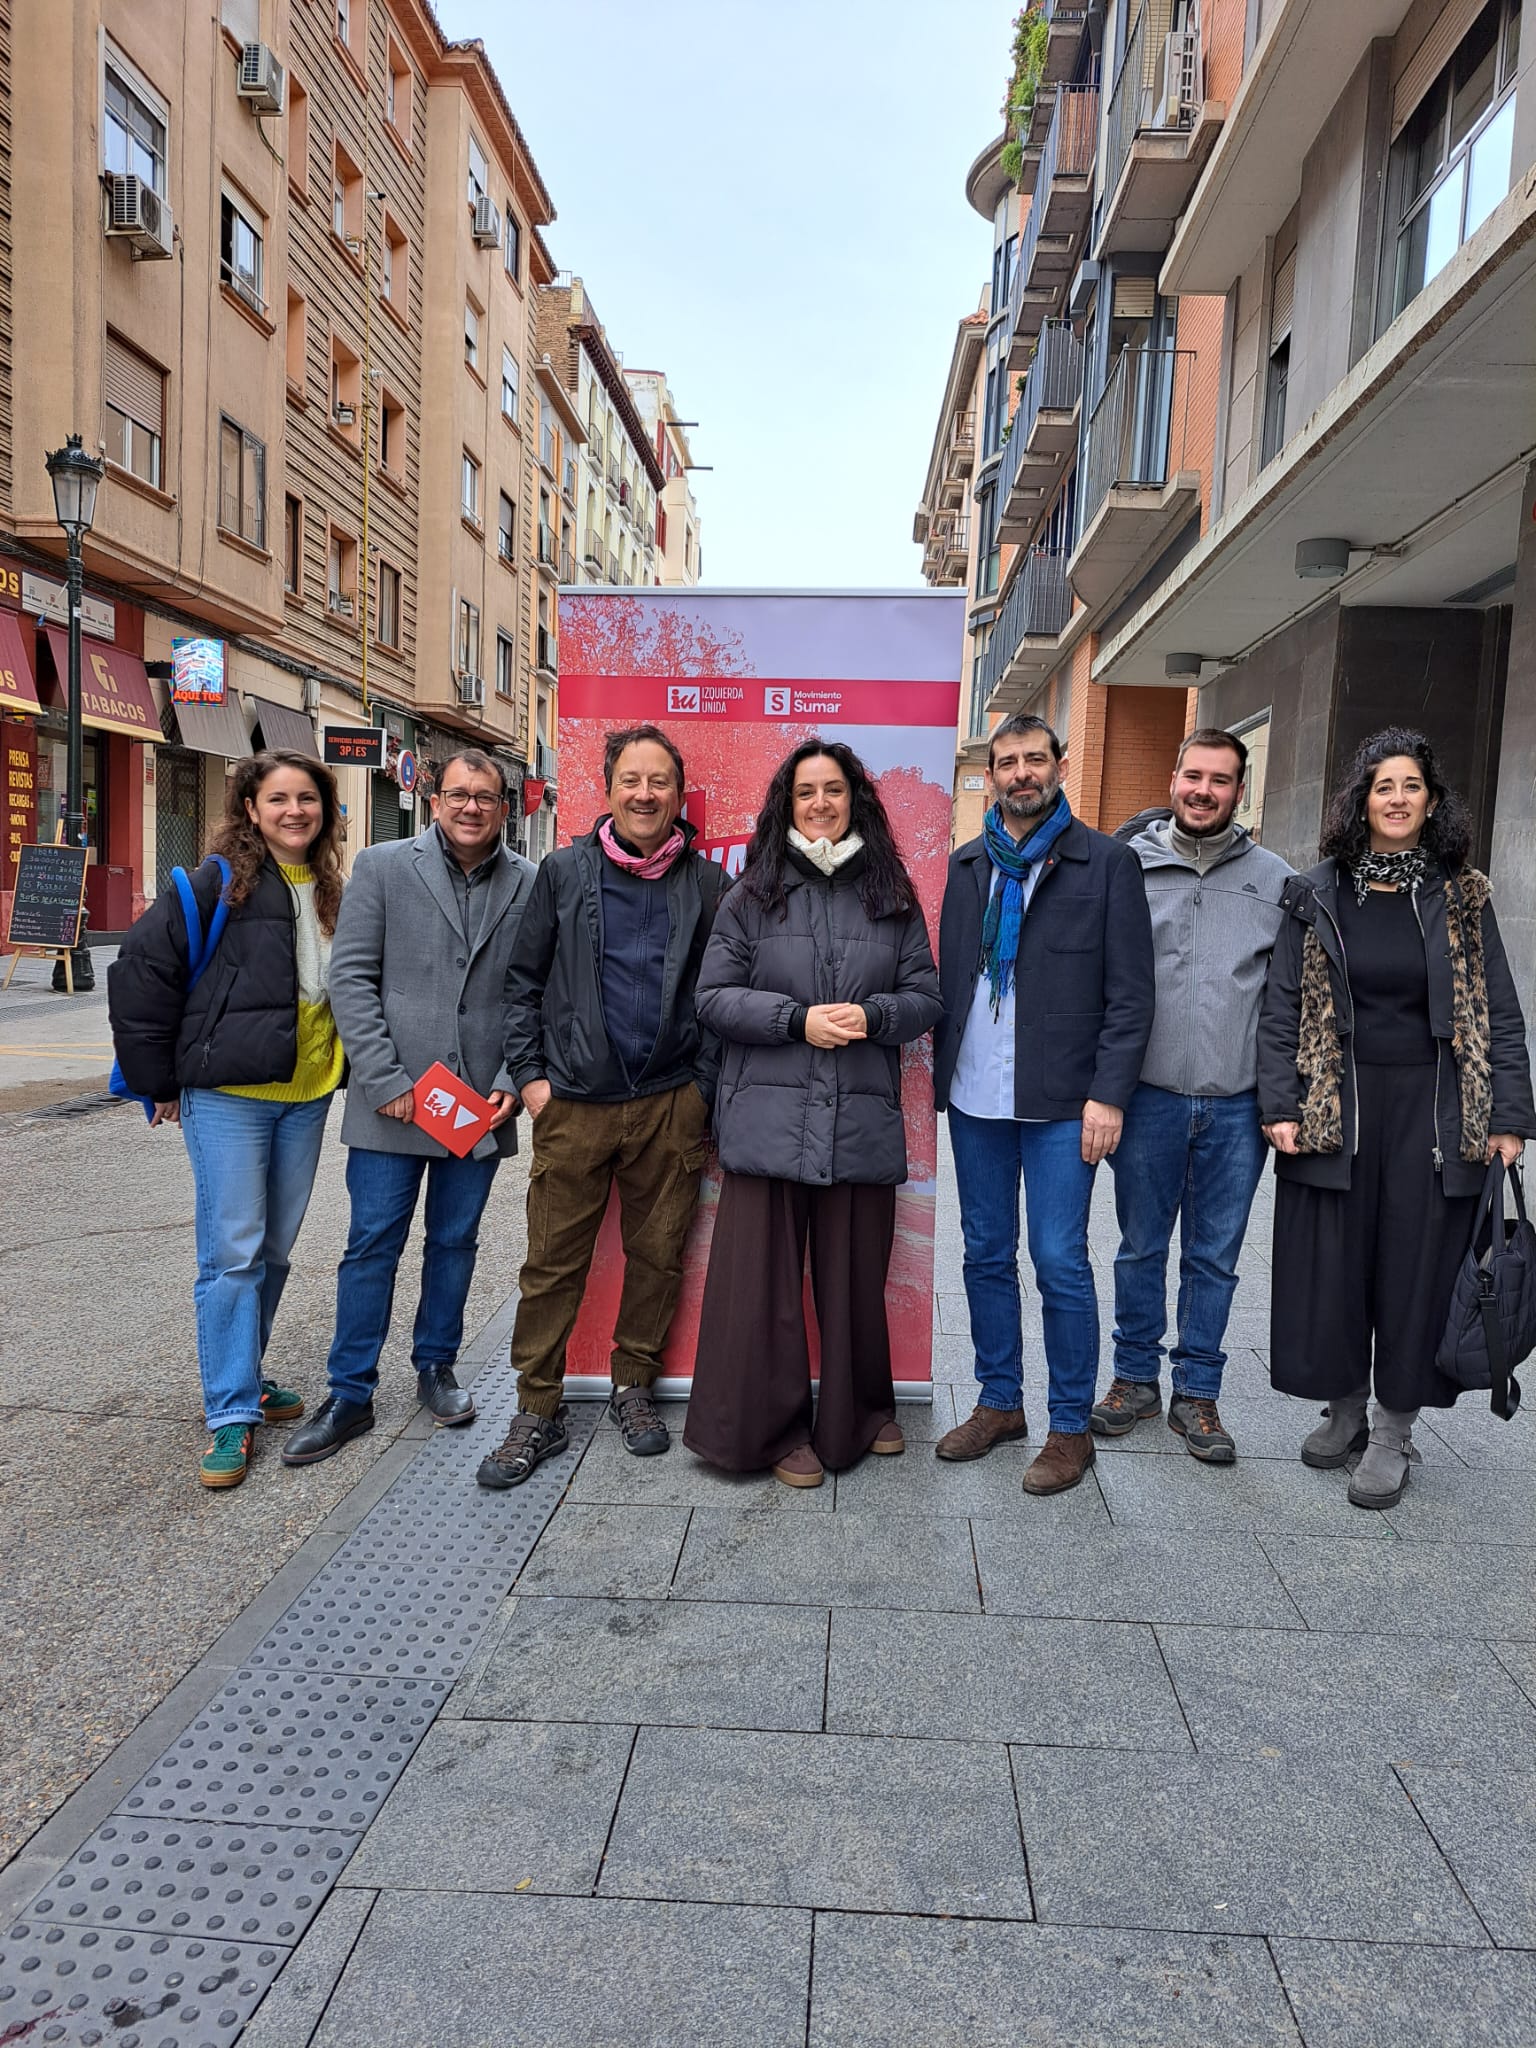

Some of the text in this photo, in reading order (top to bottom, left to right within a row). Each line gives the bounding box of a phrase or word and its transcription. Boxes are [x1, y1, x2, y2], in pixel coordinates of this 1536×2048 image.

[202, 691, 222, 702] TUS
[702, 687, 744, 701] IZQUIERDA
[794, 690, 842, 700] Movimiento
[82, 691, 146, 722] TABACOS
[702, 701, 727, 714] UNIDA
[794, 699, 841, 714] Sumar
[9, 749, 29, 768] PRENSA
[9, 770, 33, 789] REVISTAS
